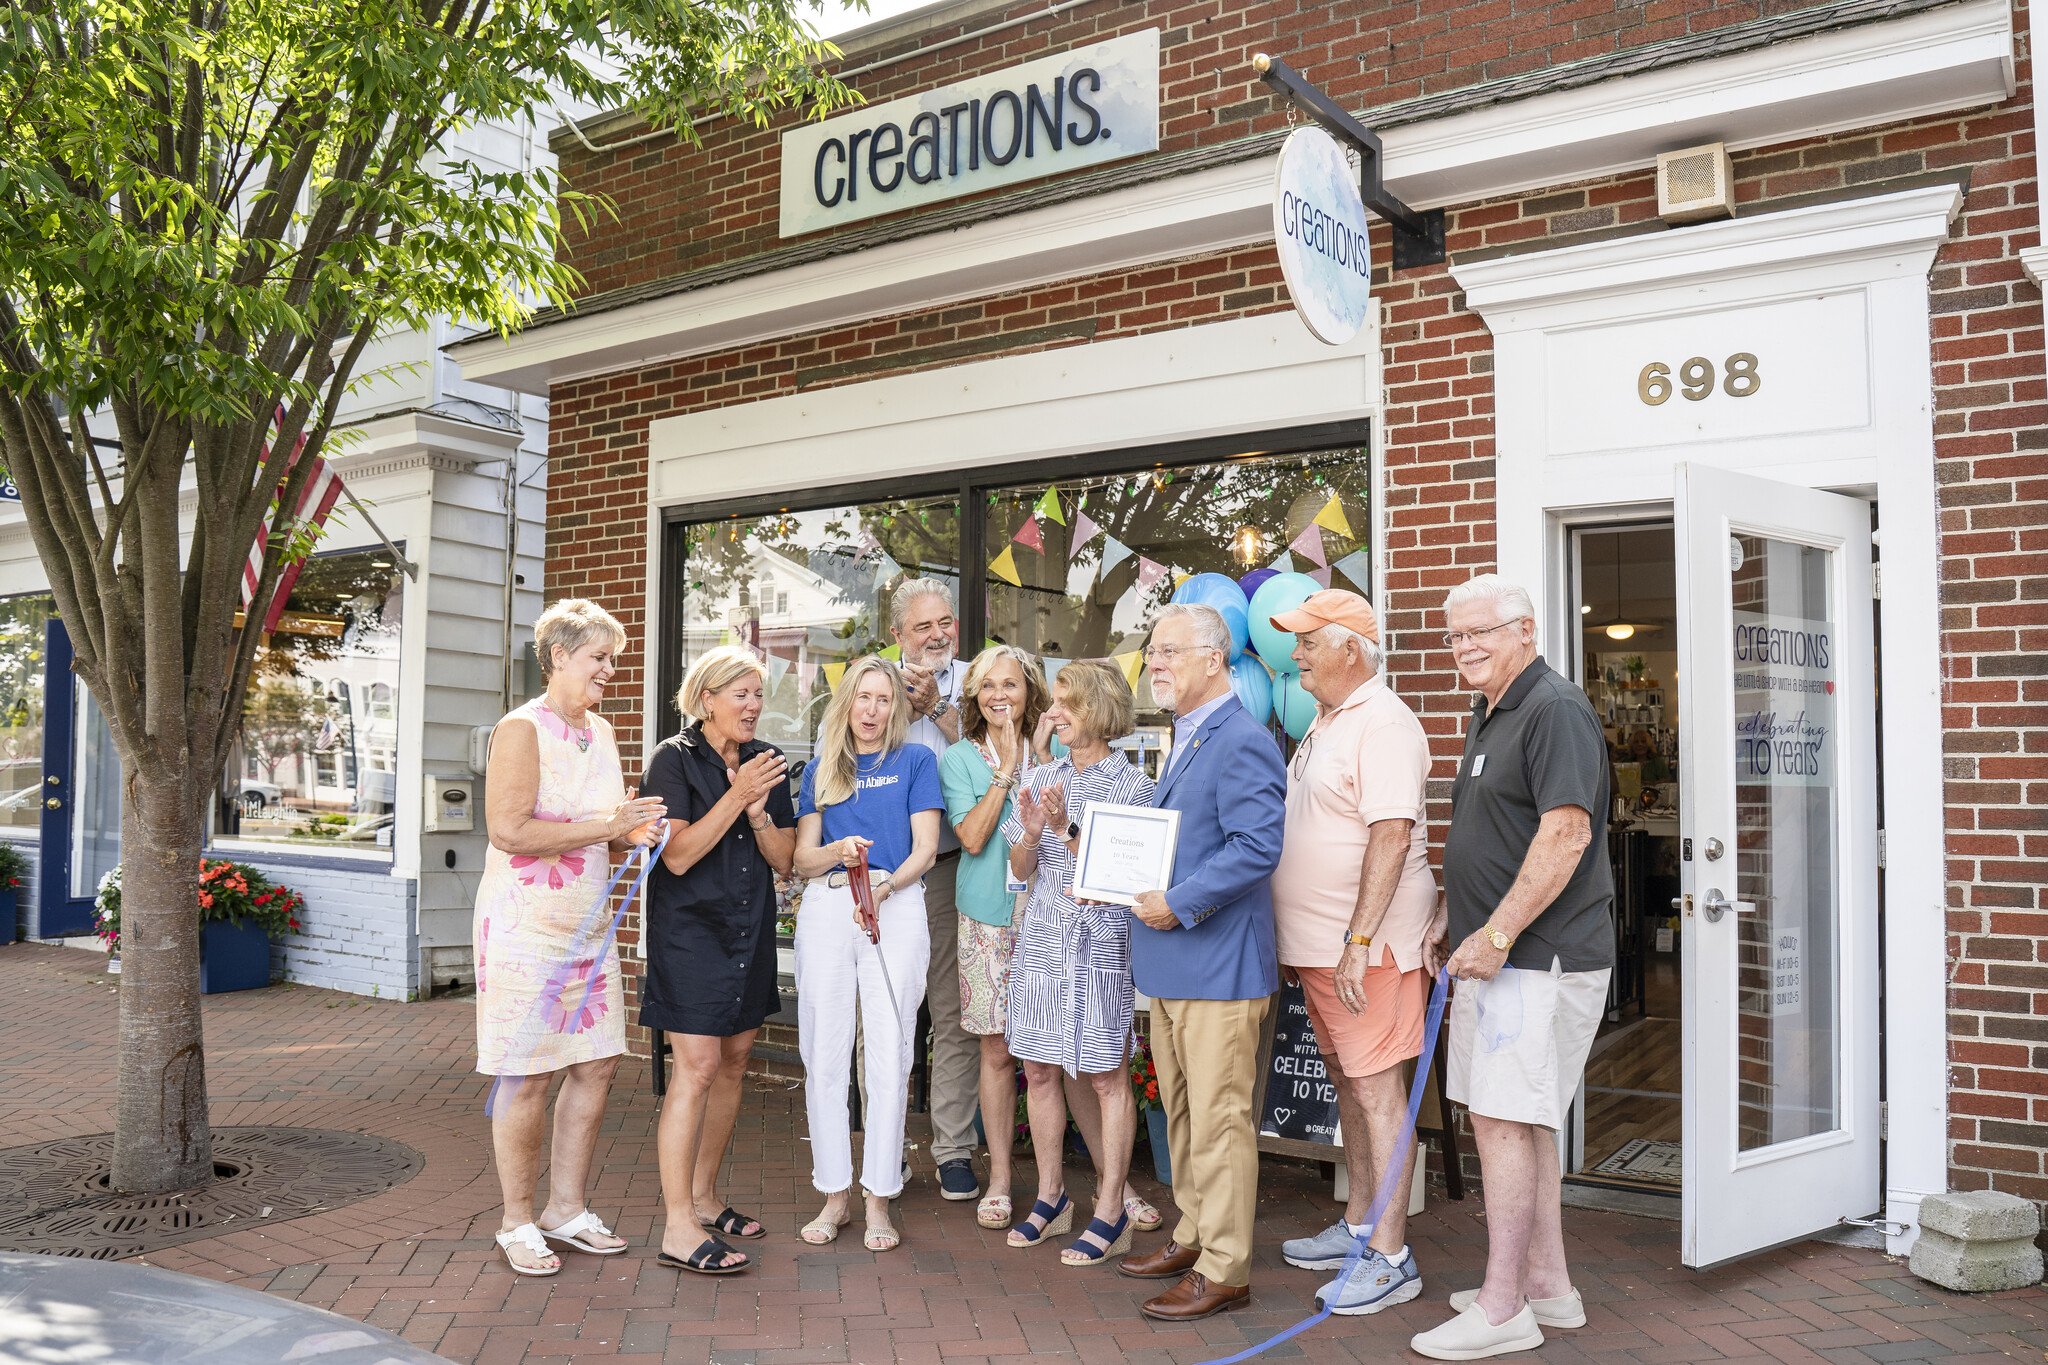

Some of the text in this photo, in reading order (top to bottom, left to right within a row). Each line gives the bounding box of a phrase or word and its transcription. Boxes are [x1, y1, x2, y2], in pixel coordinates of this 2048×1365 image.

[1638, 352, 1761, 406] 698
[1737, 711, 1829, 750] celebrating
[1746, 739, 1771, 775] 10
[865, 775, 899, 788] Abilities
[1110, 836, 1145, 848] Creations
[1294, 1043, 1317, 1055] WITH
[1293, 1080, 1310, 1099] 10
